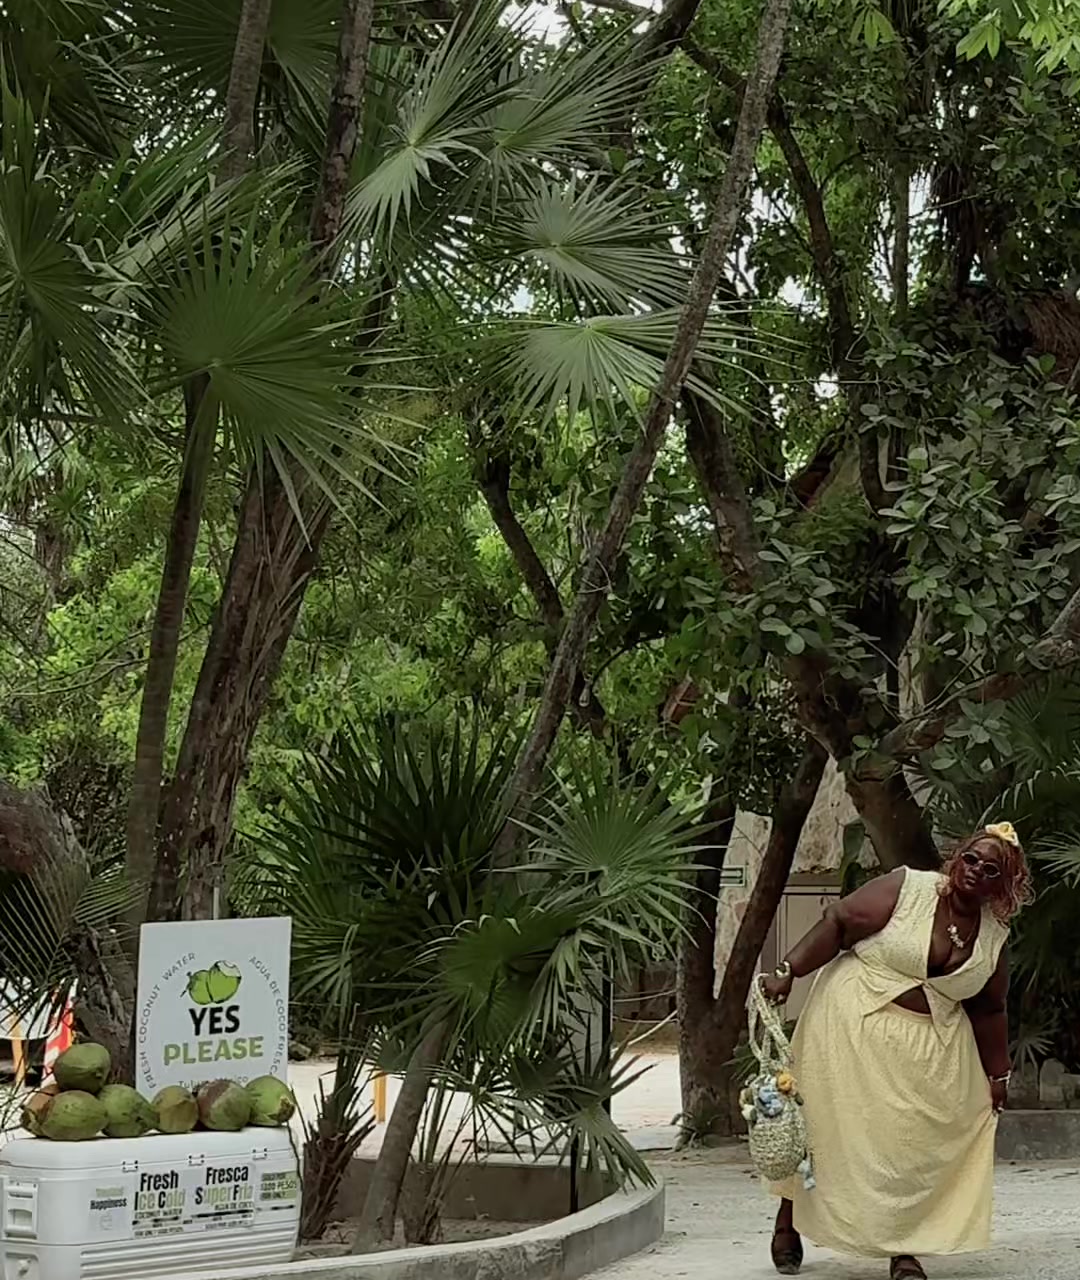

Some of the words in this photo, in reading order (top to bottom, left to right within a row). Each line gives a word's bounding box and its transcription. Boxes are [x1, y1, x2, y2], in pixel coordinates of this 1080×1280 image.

[162, 952, 196, 982] WATER
[249, 956, 271, 981] AGUA
[269, 981, 281, 996] DE
[139, 984, 161, 1044] COCONUT
[188, 1005, 241, 1036] YES
[276, 999, 286, 1032] COCO
[163, 1036, 265, 1066] PLEASE
[270, 1035, 285, 1075] FRESC
[139, 1051, 157, 1089] FRESH
[140, 1170, 179, 1192] Fresh
[206, 1166, 249, 1186] Fresca
[134, 1191, 156, 1211] Ice
[158, 1188, 185, 1208] Cold
[195, 1185, 233, 1205] Super
